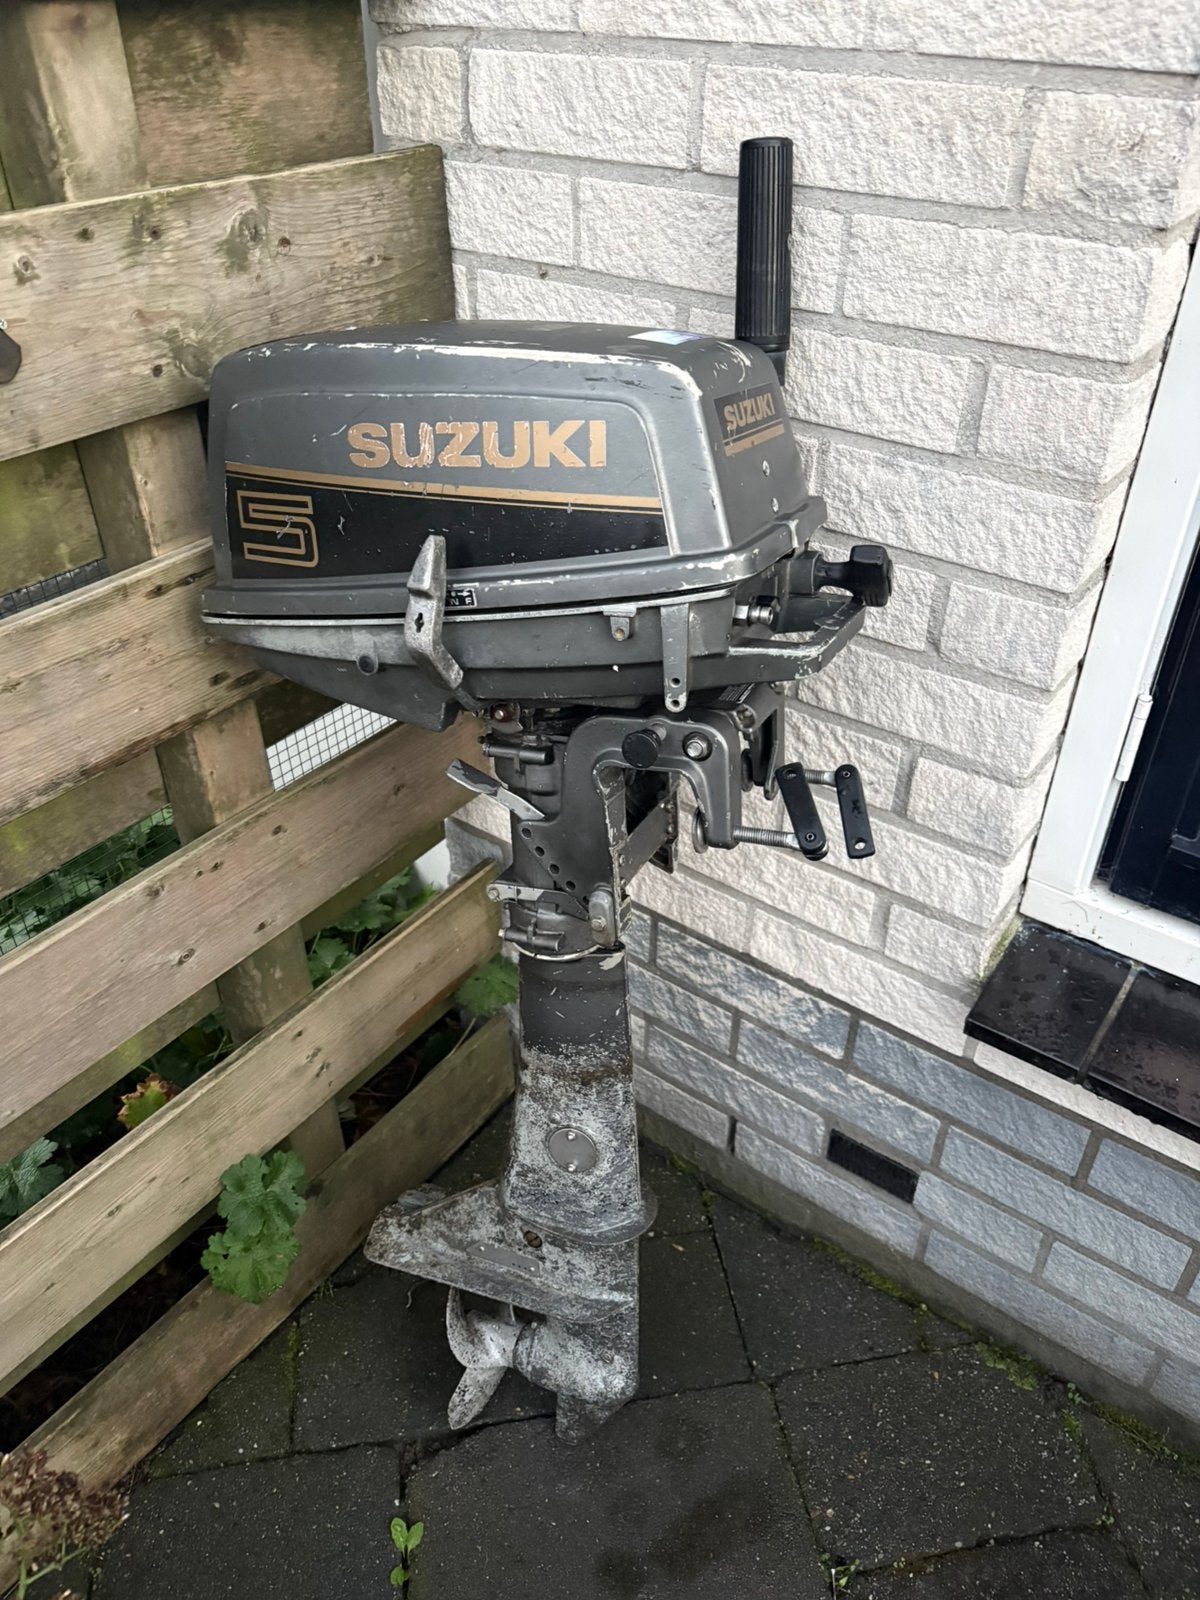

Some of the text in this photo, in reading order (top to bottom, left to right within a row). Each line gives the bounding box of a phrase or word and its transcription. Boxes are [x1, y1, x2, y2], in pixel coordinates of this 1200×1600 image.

[723, 393, 776, 430] SUZUKI
[347, 420, 607, 468] SUZUKI
[236, 490, 319, 568] 5
